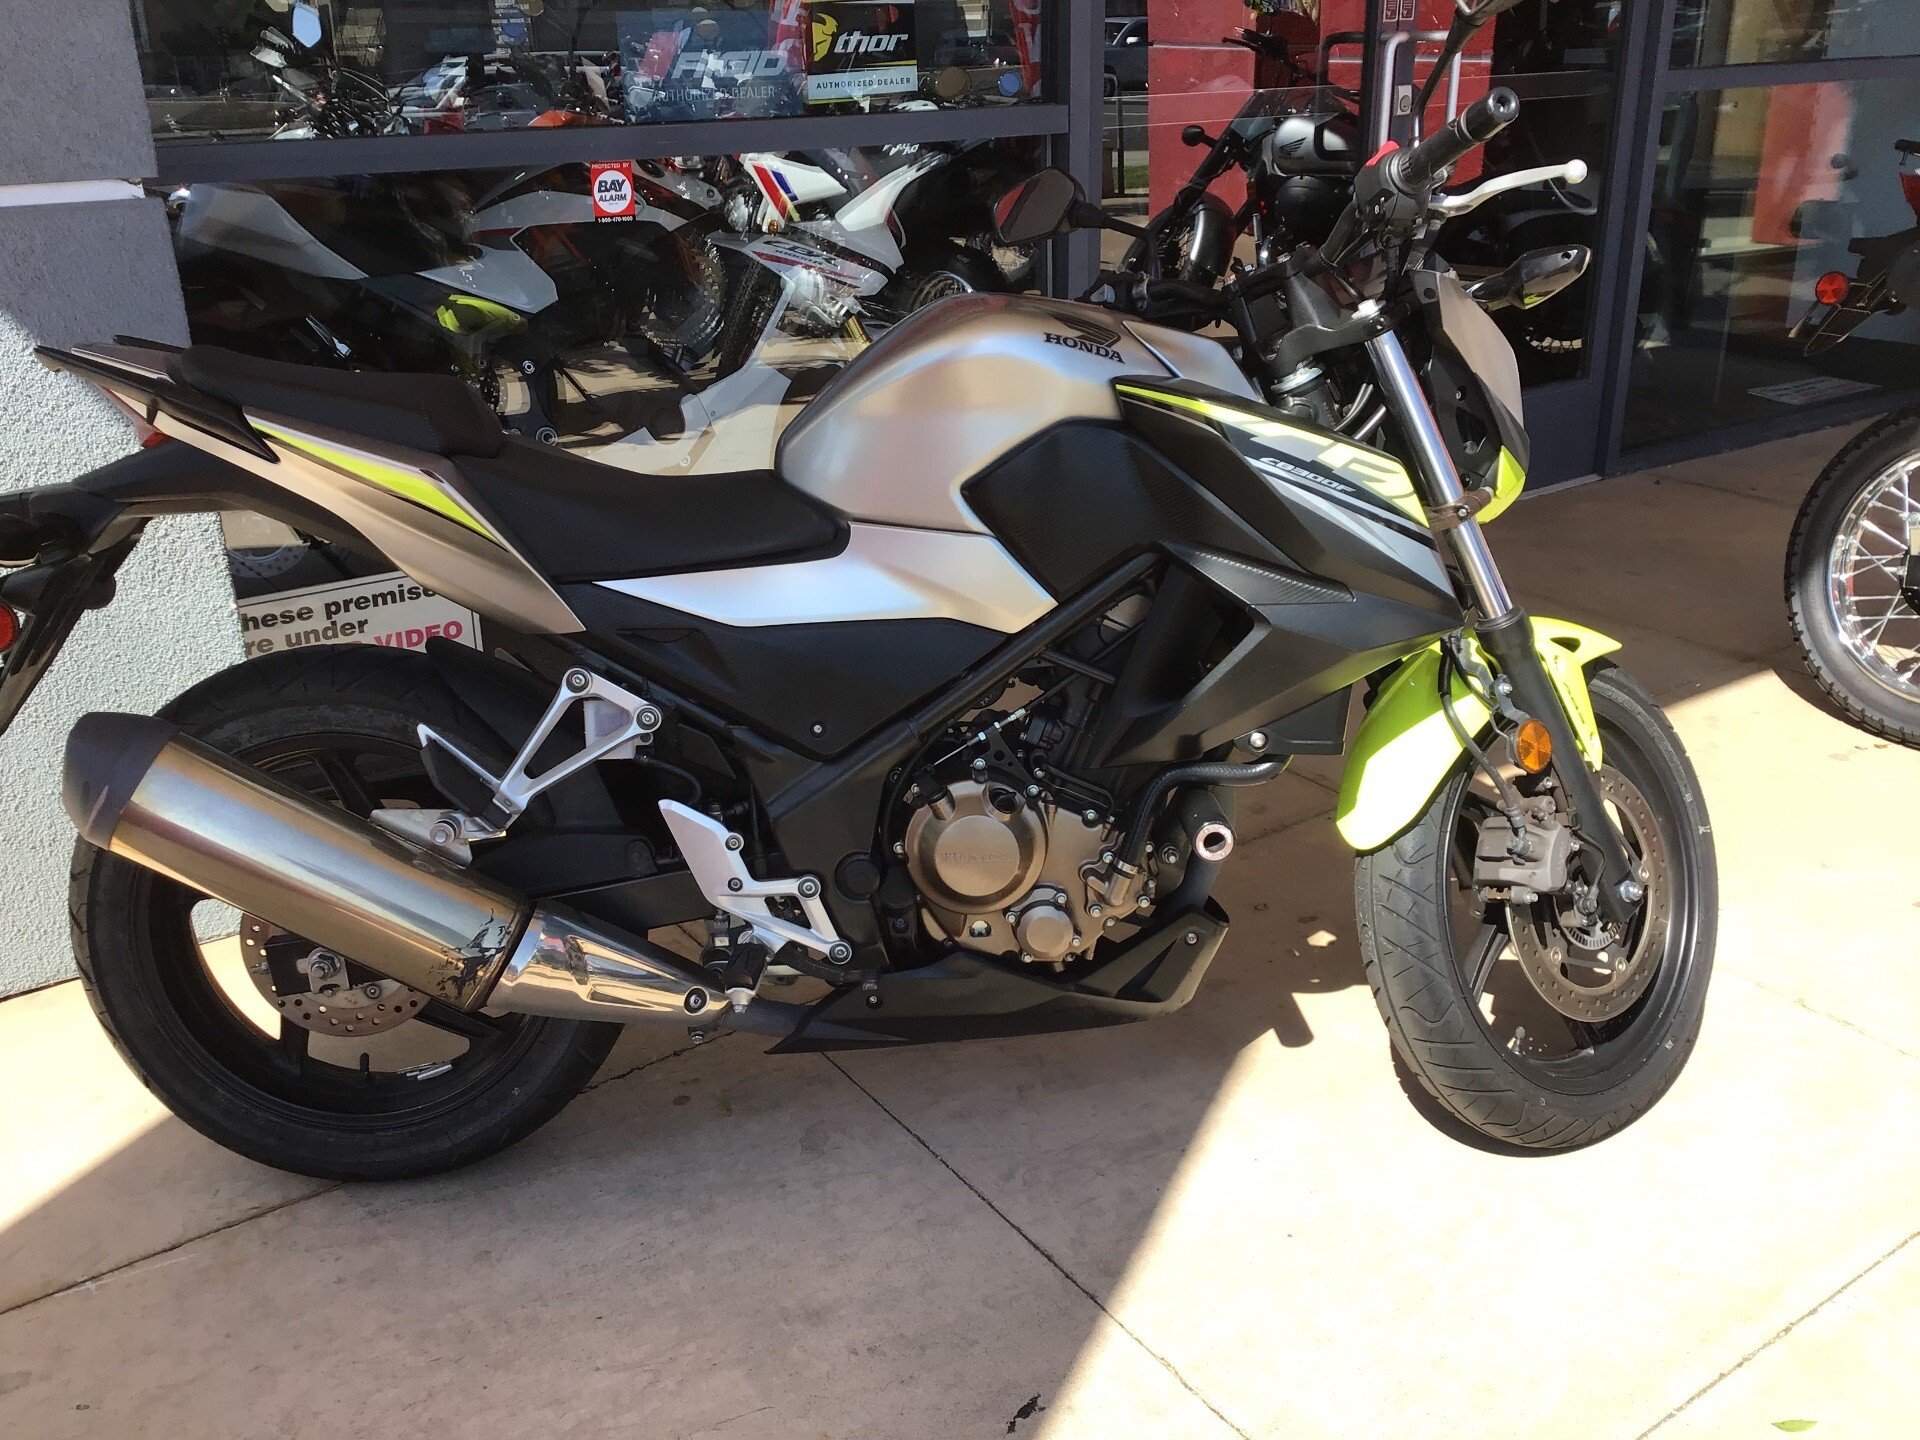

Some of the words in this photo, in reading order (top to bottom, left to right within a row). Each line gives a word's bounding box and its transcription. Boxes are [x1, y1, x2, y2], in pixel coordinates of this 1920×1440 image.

[834, 31, 908, 53] thor
[731, 86, 775, 98] DEALER
[816, 80, 874, 89] AUTHORIZED
[877, 77, 911, 86] DEALER
[597, 179, 627, 193] BAY
[598, 193, 628, 202] ALARM
[1043, 332, 1125, 364] HONDA
[1259, 457, 1357, 493] CB300F
[285, 618, 368, 648] under
[374, 620, 463, 650] VIDEO
